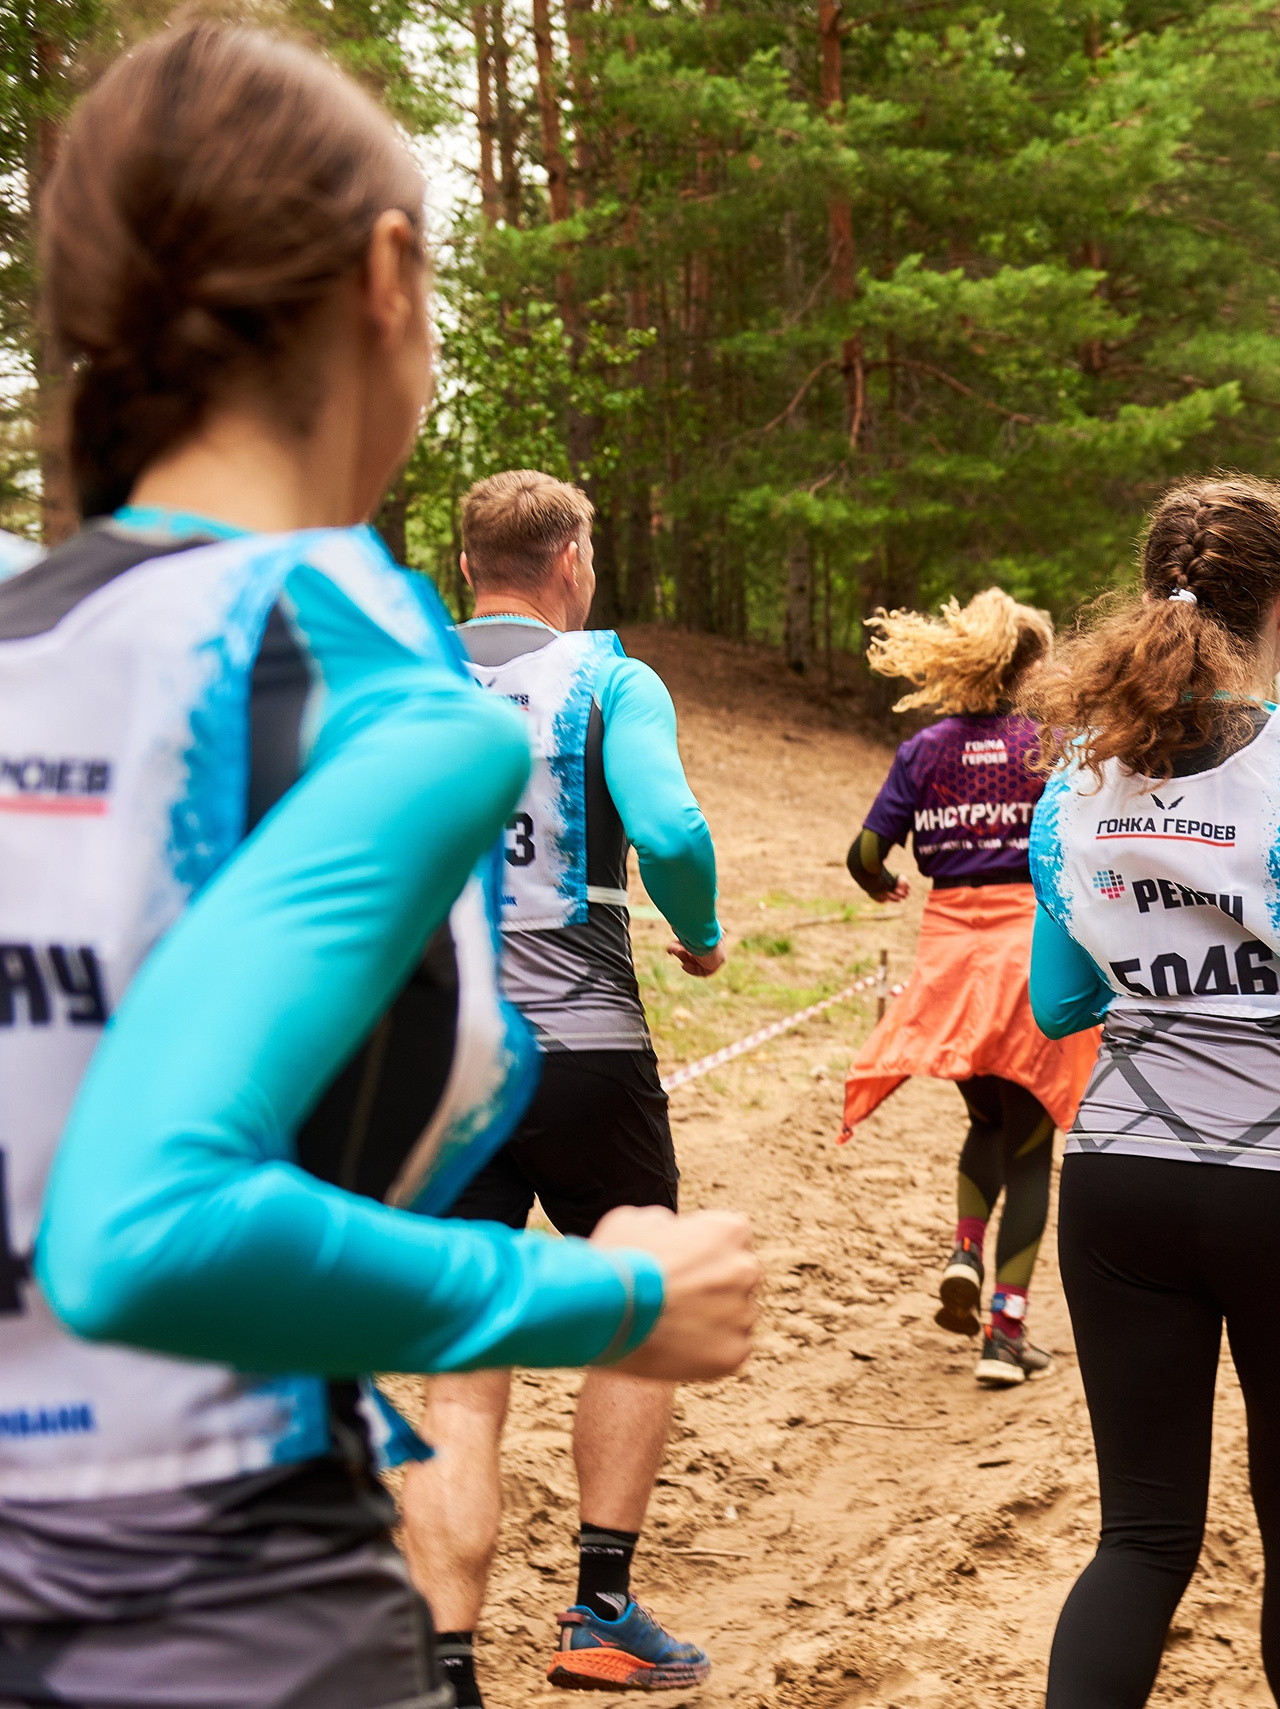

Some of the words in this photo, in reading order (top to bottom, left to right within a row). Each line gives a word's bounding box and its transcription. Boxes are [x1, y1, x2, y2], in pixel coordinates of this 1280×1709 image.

[914, 801, 1034, 832] ИНСТРУКТ
[1096, 817, 1156, 835] ГОНКА
[1163, 817, 1236, 841] ГЕРОЕВ
[1108, 939, 1280, 998] 5046
